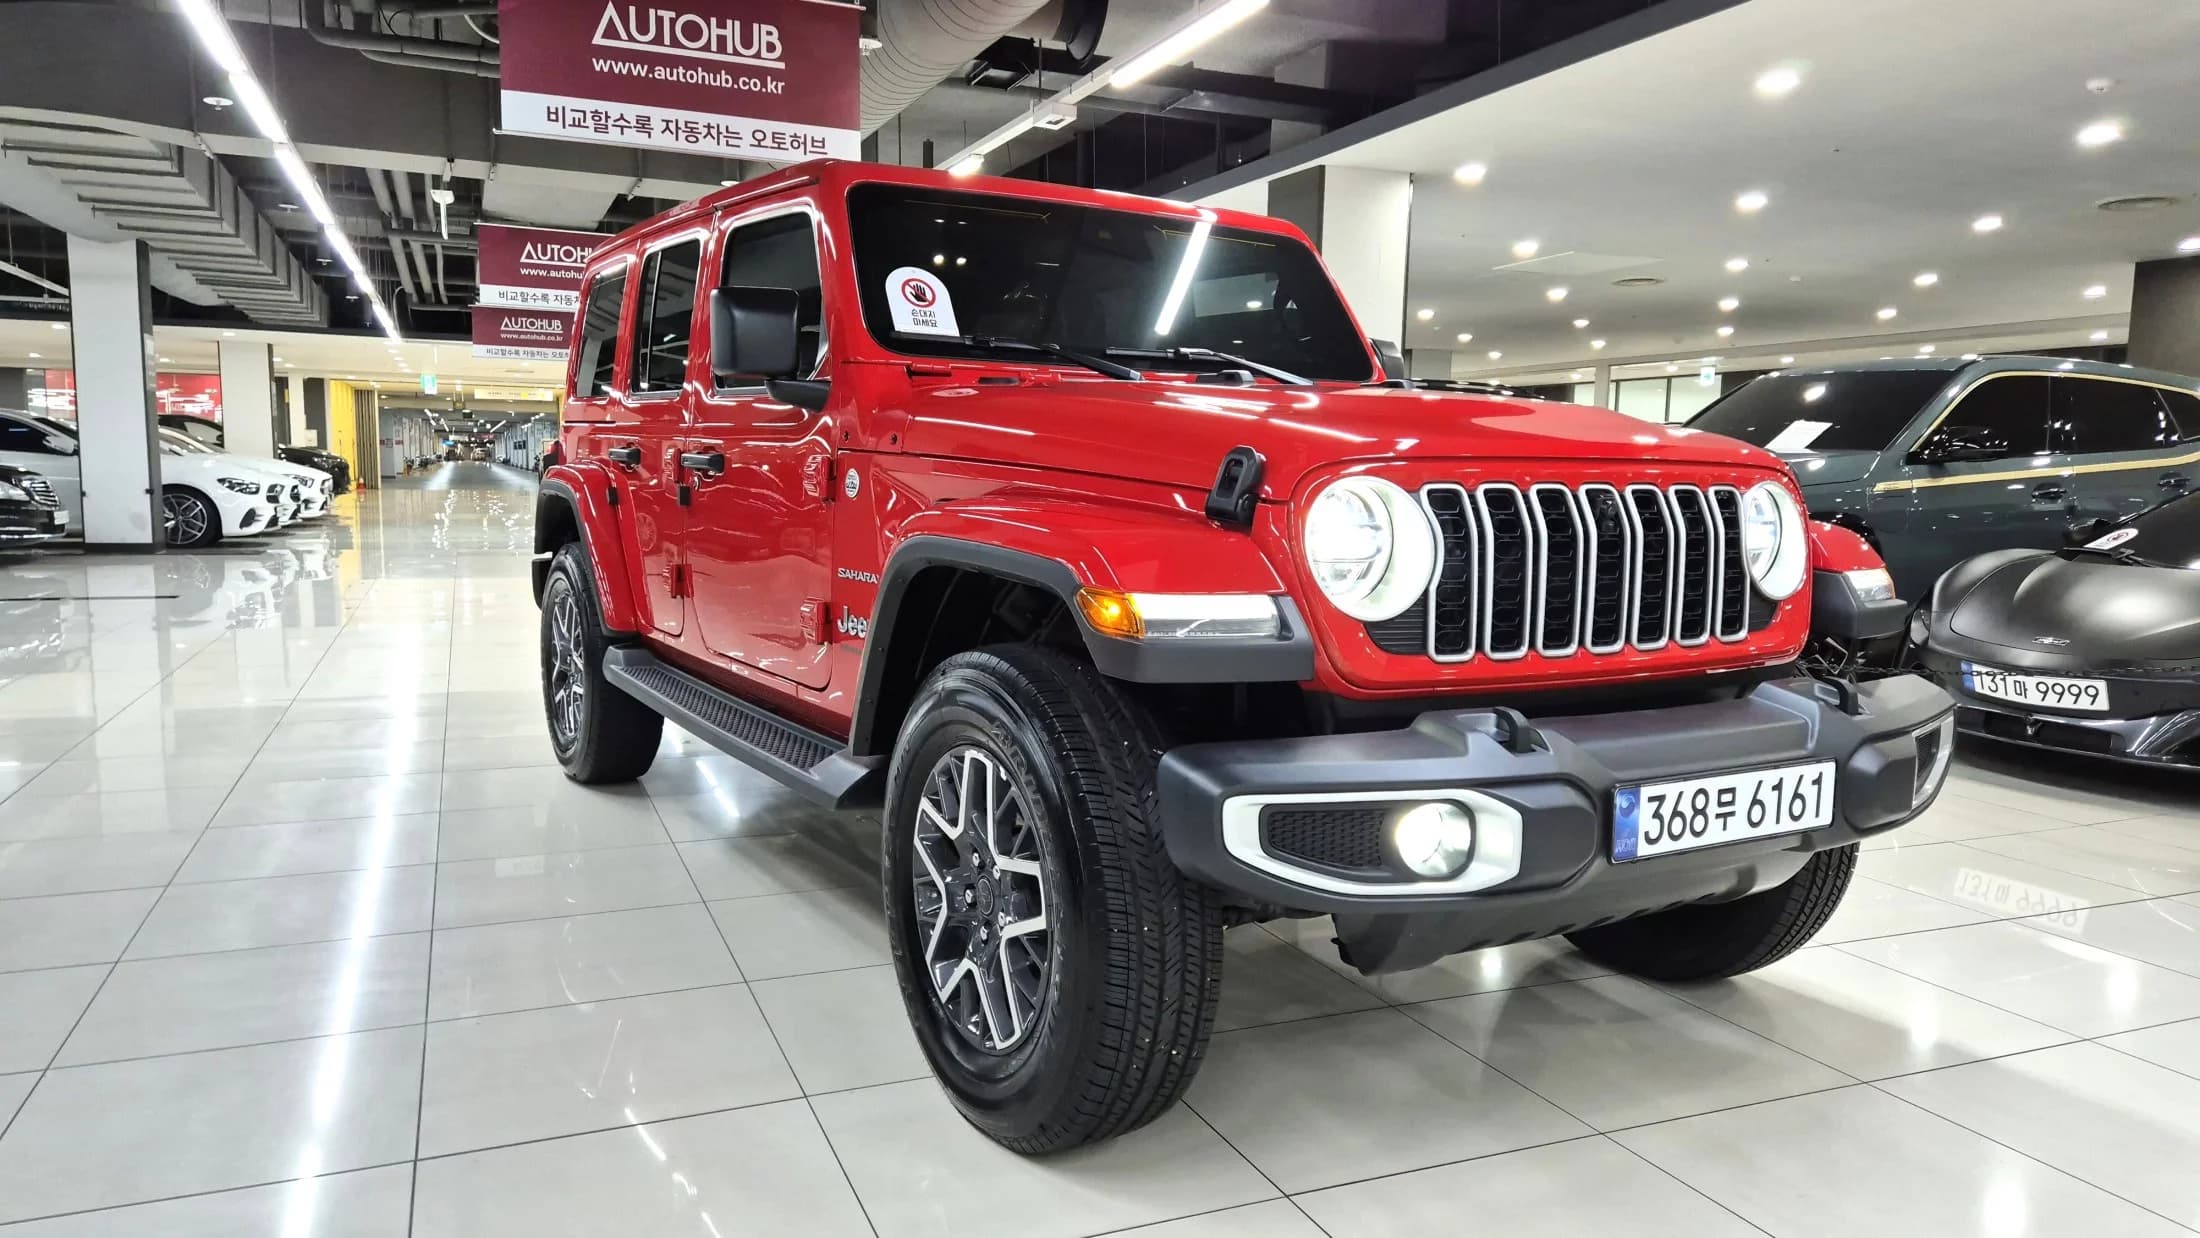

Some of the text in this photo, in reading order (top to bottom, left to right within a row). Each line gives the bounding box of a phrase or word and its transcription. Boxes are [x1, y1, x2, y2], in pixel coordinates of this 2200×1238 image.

[592, 0, 785, 66] AUTOHUB
[592, 57, 785, 94] www.autohub.co.kr
[546, 105, 828, 155] 비교할수록 자동차는 오토허브
[520, 241, 592, 265] AUTOH
[520, 267, 585, 279] www.autohu
[498, 290, 549, 304] 비교할수록
[500, 316, 563, 332] AUTOHUB
[911, 308, 936, 319] 손대지
[500, 332, 563, 341] www.autohub.co.kr
[838, 567, 878, 584] SAHARA
[837, 605, 870, 639] Jee
[2035, 681, 2099, 706] 9999
[1747, 771, 1824, 829] 6161
